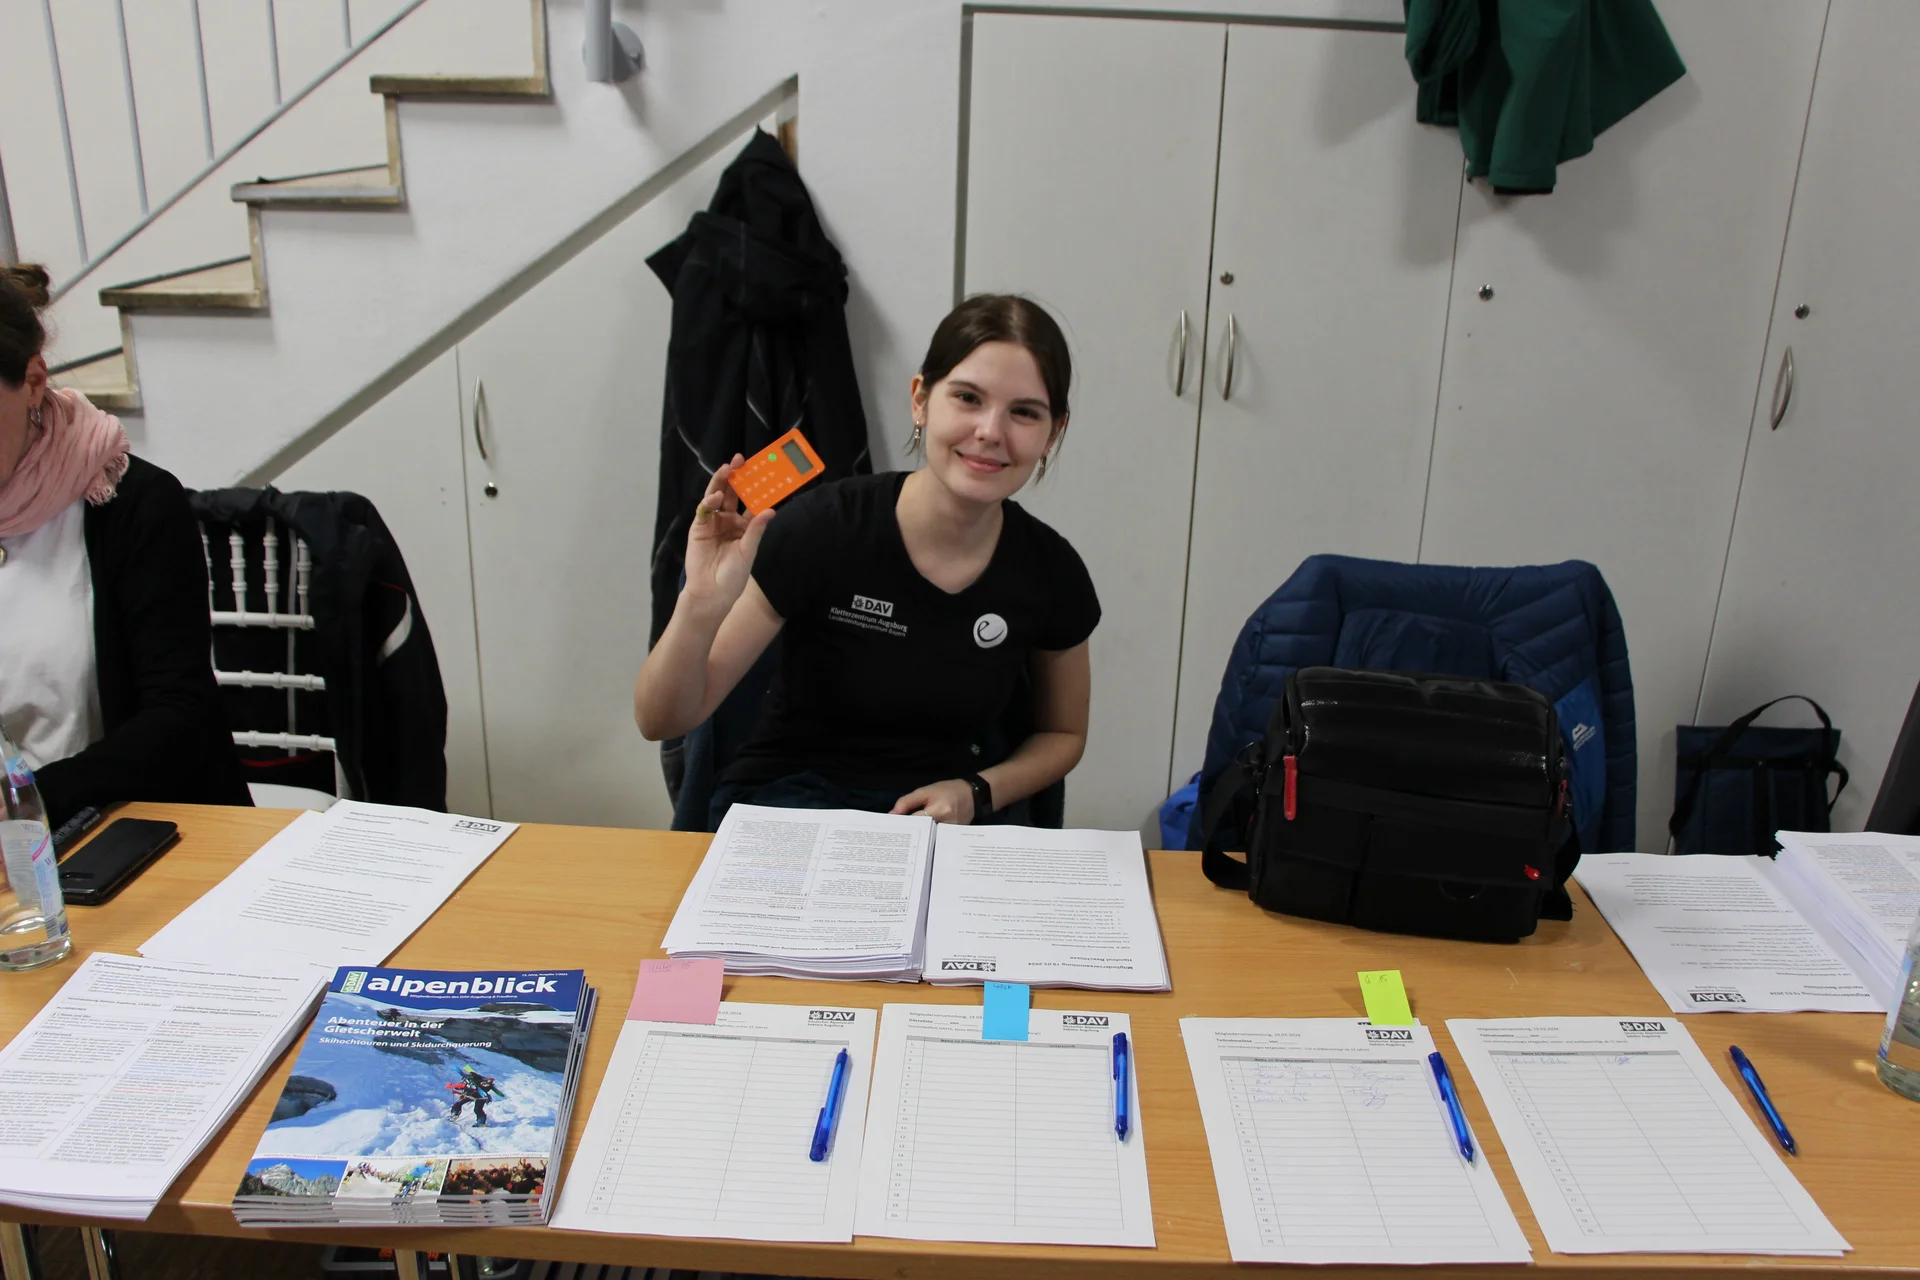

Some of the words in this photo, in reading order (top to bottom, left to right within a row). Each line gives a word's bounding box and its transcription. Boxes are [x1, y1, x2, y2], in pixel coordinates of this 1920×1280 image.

[864, 600, 892, 615] DAV
[830, 606, 878, 624] Kletterzentrum
[878, 618, 908, 632] Augsburg
[470, 822, 500, 832] DAV
[368, 976, 558, 996] alpenblick
[823, 1012, 854, 1020] DAV
[327, 1016, 401, 1027] Abenteuer
[404, 1020, 418, 1028] in
[324, 1026, 421, 1037] Gletscherwelt
[319, 1037, 388, 1047] Skihochtouren
